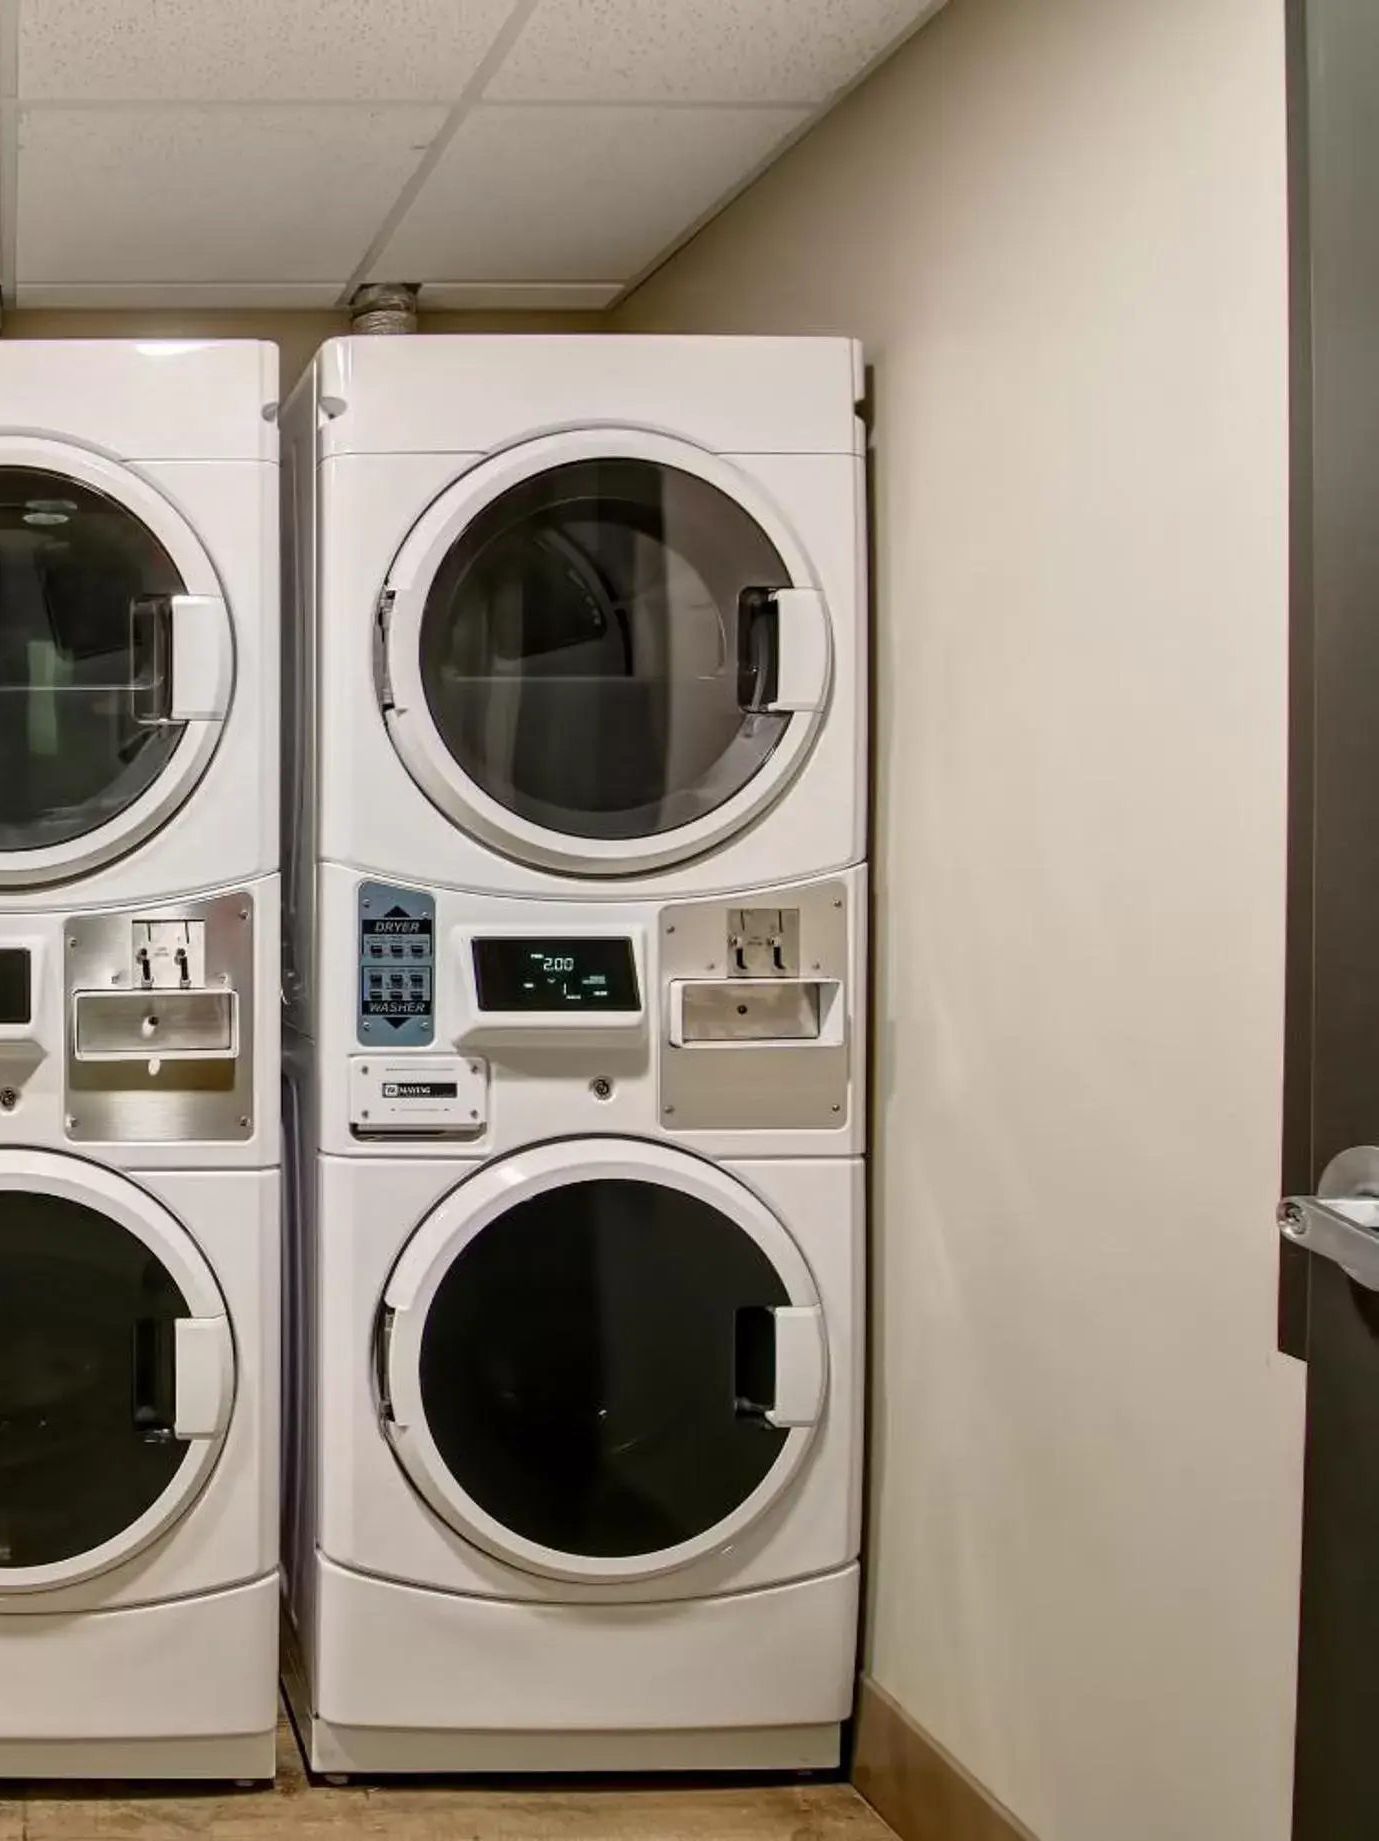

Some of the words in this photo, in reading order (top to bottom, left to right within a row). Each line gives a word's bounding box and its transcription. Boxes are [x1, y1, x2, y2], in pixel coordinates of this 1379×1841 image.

[375, 921, 420, 933] DRYER
[543, 957, 574, 971] 2.00
[370, 1002, 425, 1013] WASHER
